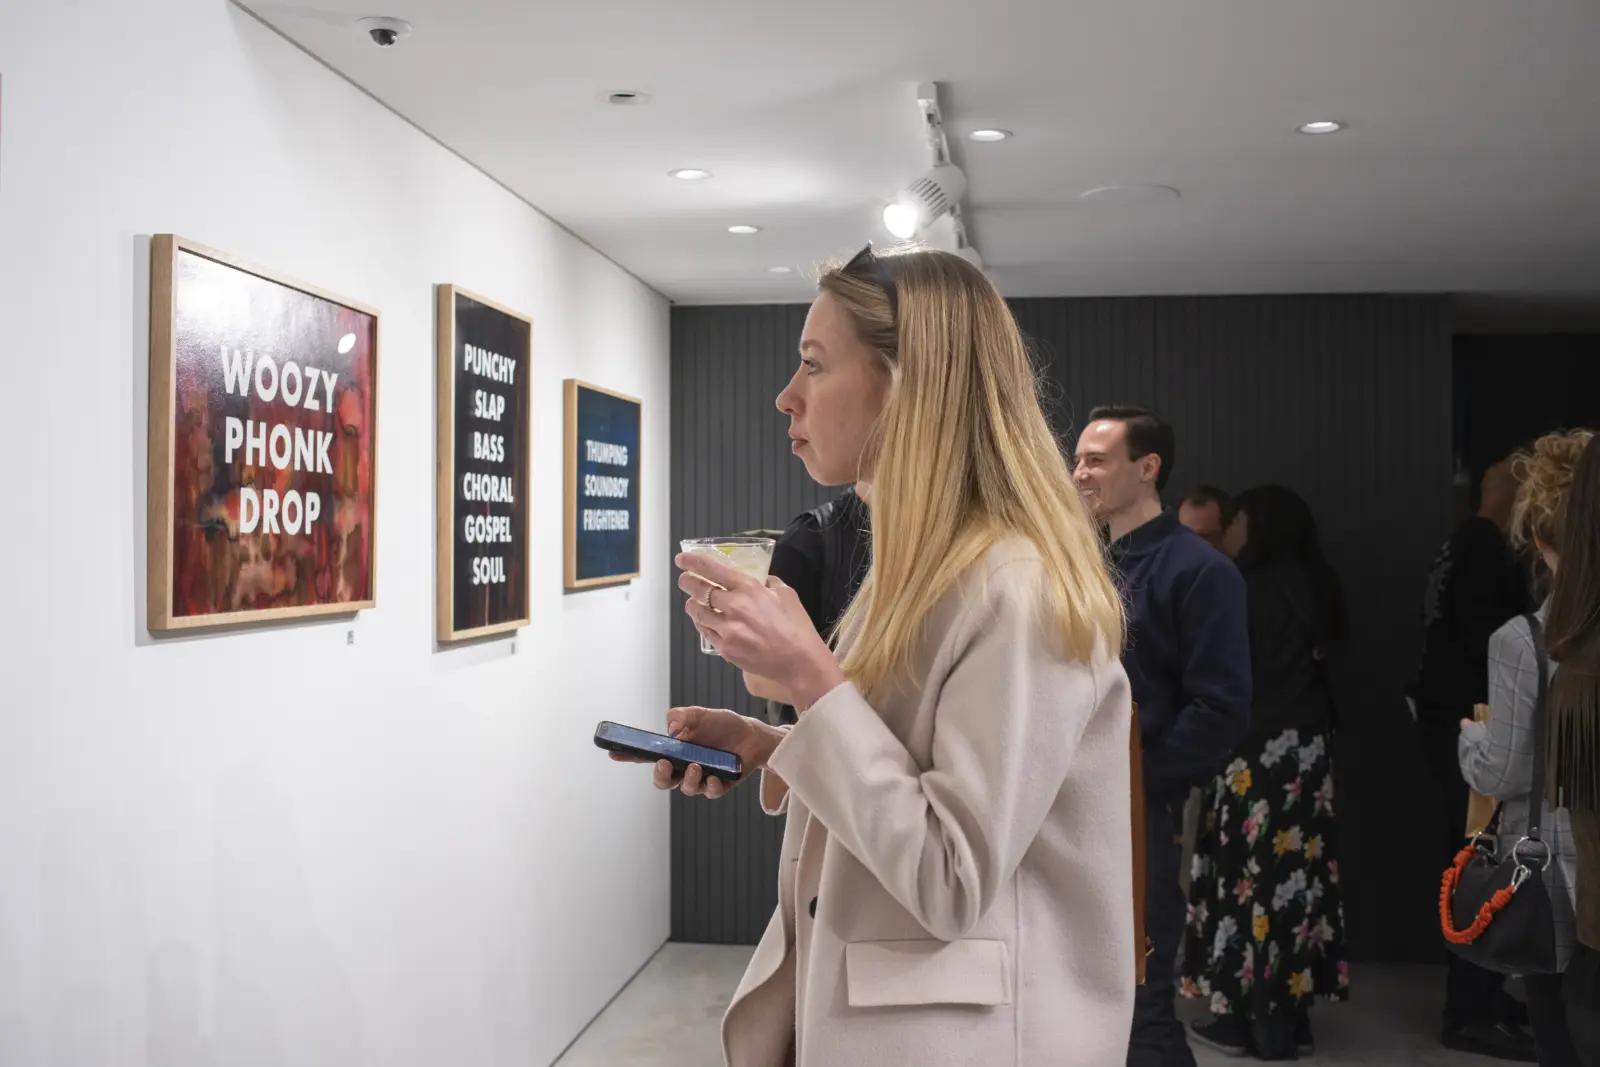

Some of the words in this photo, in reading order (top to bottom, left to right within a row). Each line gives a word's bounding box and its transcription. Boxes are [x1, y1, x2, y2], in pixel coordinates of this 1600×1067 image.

[221, 345, 338, 414] WOOZY
[464, 343, 516, 385] PUNCHY
[474, 390, 505, 421] SLAP
[224, 416, 333, 474] PHONK
[473, 432, 504, 463] BASS
[585, 439, 628, 467] THUMPING
[463, 472, 514, 503] CHORAL
[239, 486, 321, 535] DROP
[583, 509, 629, 531] FRIGHTENER
[464, 514, 512, 544] GOSPEL
[473, 556, 506, 585] SOUL
